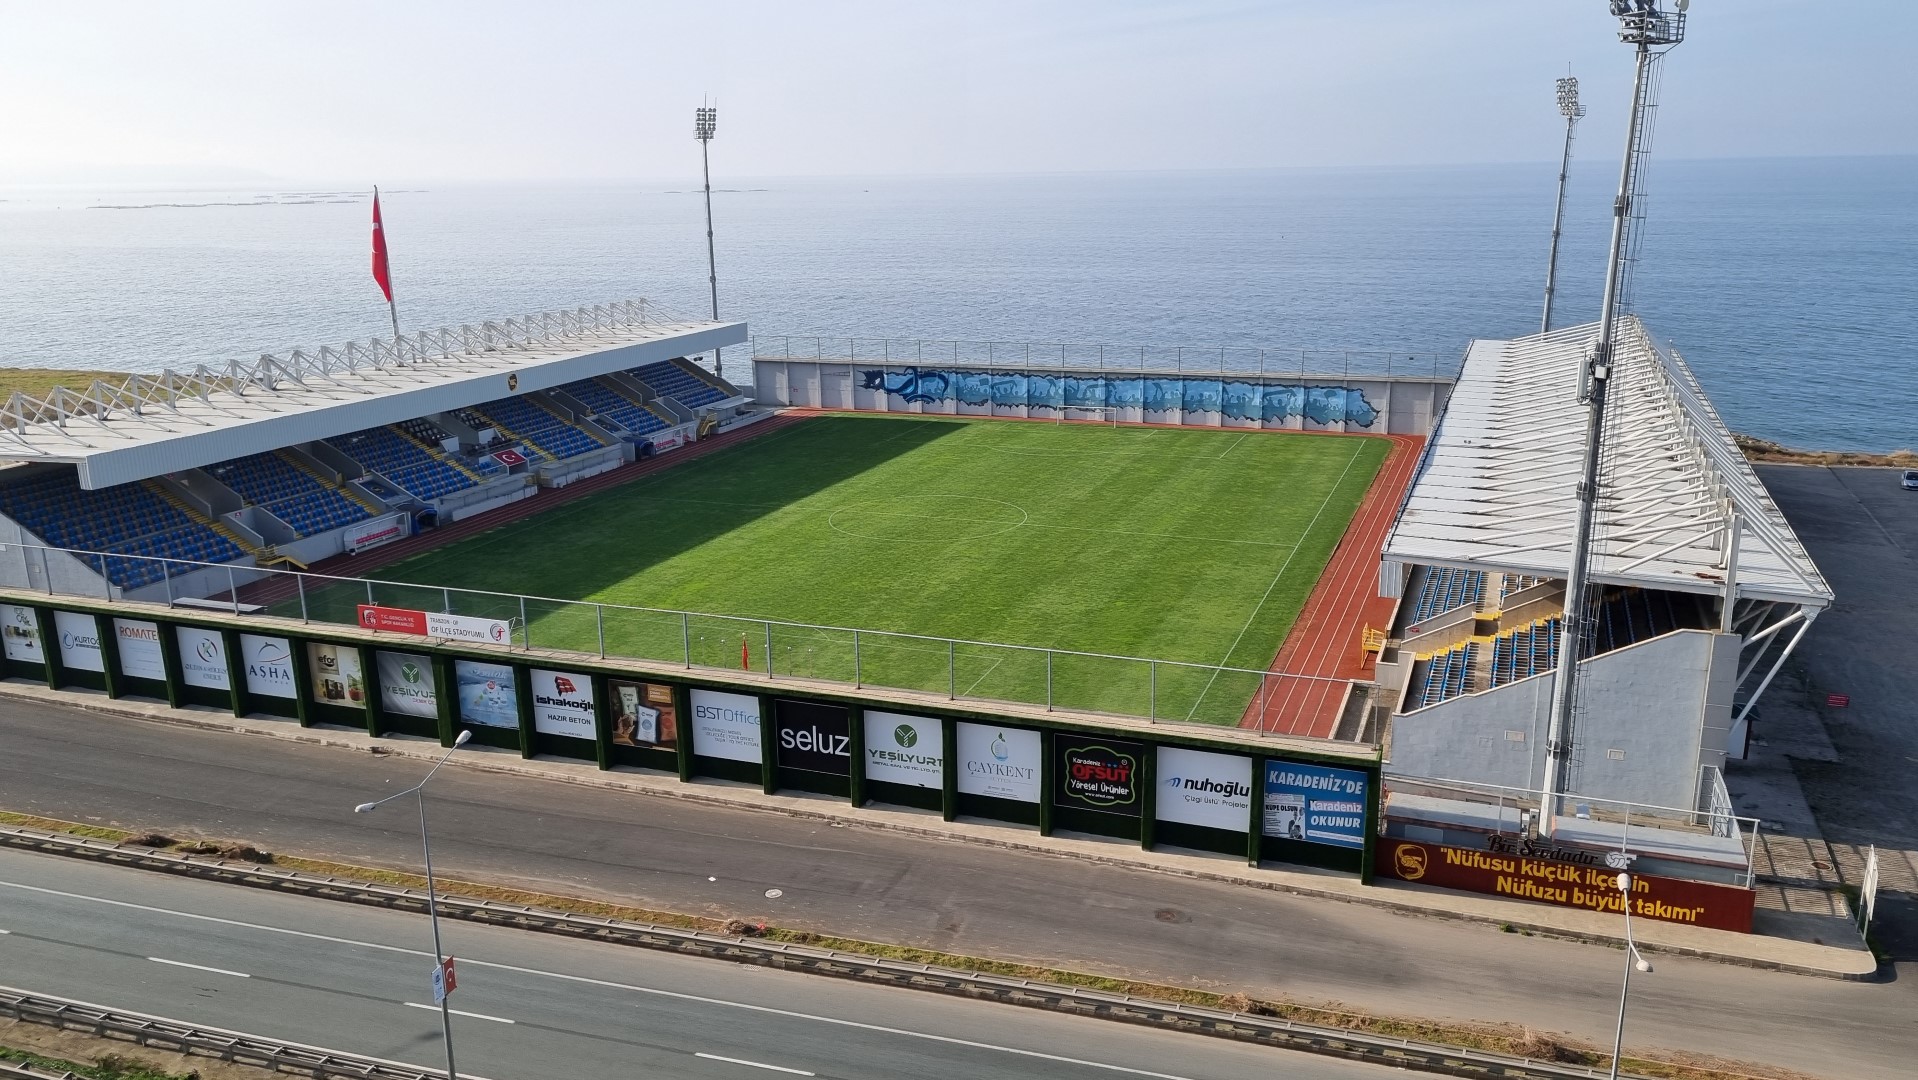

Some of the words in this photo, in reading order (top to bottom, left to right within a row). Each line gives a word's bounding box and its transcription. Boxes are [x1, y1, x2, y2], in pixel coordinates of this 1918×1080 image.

[430, 617, 450, 625] TRABZON
[440, 625, 451, 636] İLÇE
[453, 628, 485, 638] STADYUMU
[250, 664, 290, 681] AŞHA
[547, 714, 567, 722] HAZIR
[569, 717, 591, 725] BETON
[781, 725, 850, 757] seluz
[868, 749, 943, 767] YEŞİLYURT
[1072, 757, 1101, 766] Karadeniz
[967, 760, 1034, 780] ÇAYKENT
[1072, 764, 1129, 782] OFSUT
[1070, 779, 1098, 791] Yöresel
[1100, 782, 1130, 795] Ürünler
[1183, 777, 1249, 798] nuhoğlu
[1309, 800, 1362, 813] Karadeniz
[1310, 816, 1360, 828] OKUNUR
[1487, 834, 1516, 854] Bir
[1519, 838, 1598, 865] Sevdadır
[1521, 858, 1582, 882] küçük
[1586, 868, 1650, 893] ilçein
[1496, 875, 1567, 903] Nüfuzu
[1572, 886, 1633, 912] büyük
